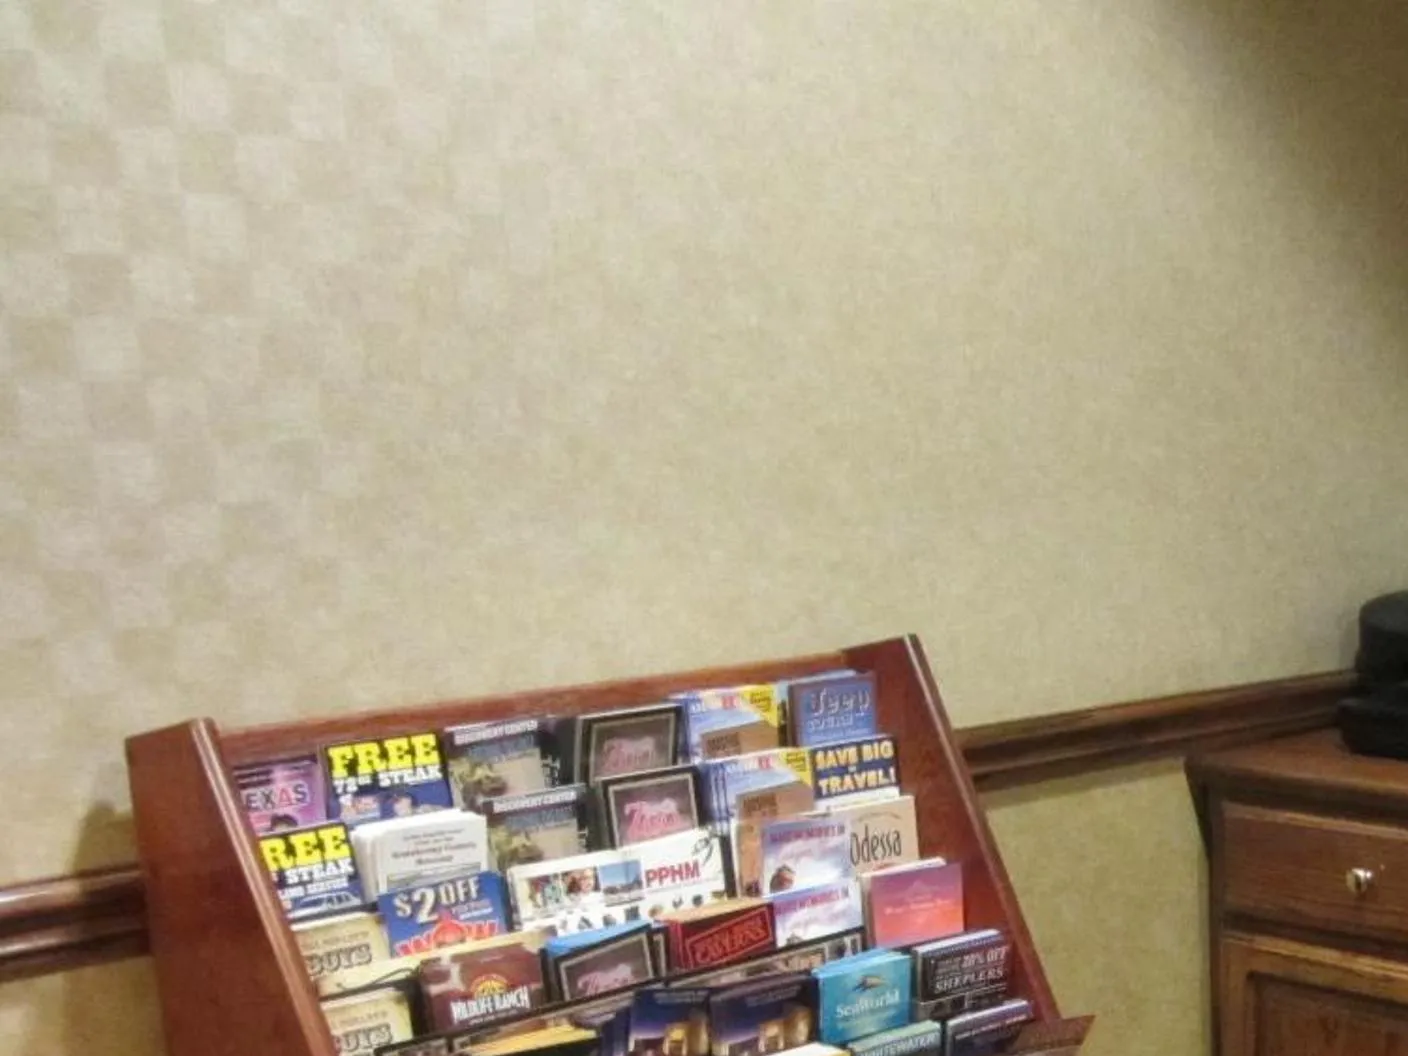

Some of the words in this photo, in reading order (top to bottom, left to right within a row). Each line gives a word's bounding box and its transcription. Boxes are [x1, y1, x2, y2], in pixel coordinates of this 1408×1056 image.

[328, 733, 440, 779] FREE
[815, 743, 857, 769] SAVE
[861, 740, 894, 763] BIG
[378, 764, 443, 788] STEAK
[817, 766, 896, 795] TRAVEL!
[244, 781, 311, 811] EXAS
[259, 826, 352, 872] REE
[850, 824, 902, 867] Odessa
[284, 858, 354, 884] STEAK
[644, 859, 700, 889] PPHM
[393, 887, 440, 924] $2
[439, 876, 480, 905] OFF
[306, 943, 373, 977] BOYS
[835, 989, 900, 1019] SeaWorld
